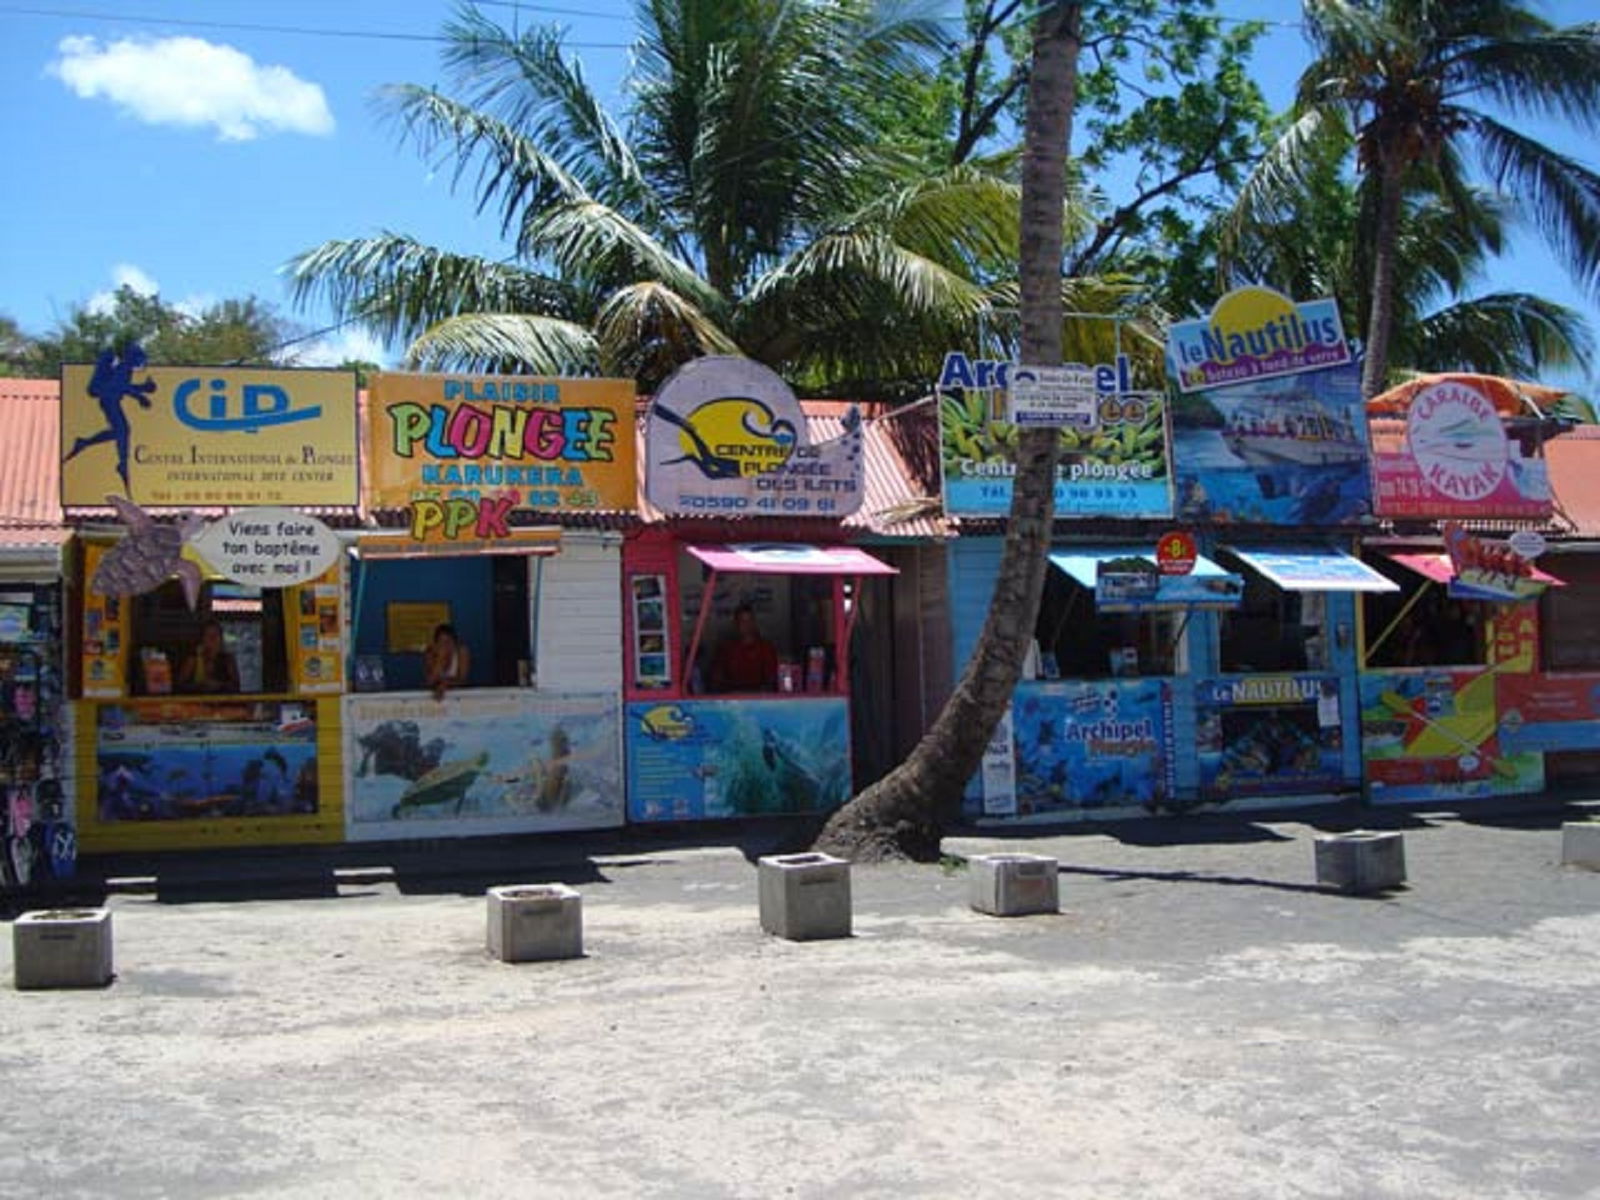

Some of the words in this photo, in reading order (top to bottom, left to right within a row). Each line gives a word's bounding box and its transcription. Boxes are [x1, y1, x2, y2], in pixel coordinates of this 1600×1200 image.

[1201, 313, 1339, 361] Nautilus
[443, 380, 559, 401] PLAISIR
[387, 401, 618, 462] PLONGEE
[166, 471, 254, 482] INTERNATIONAL
[292, 471, 334, 482] CENTER
[421, 463, 584, 486] KARUKERA
[1428, 461, 1501, 497] KAYAK
[230, 522, 270, 536] Viens
[277, 521, 315, 536] faire
[411, 498, 514, 541] PPK
[223, 541, 248, 556] ton
[254, 540, 321, 558] baptême
[232, 563, 267, 574] avec
